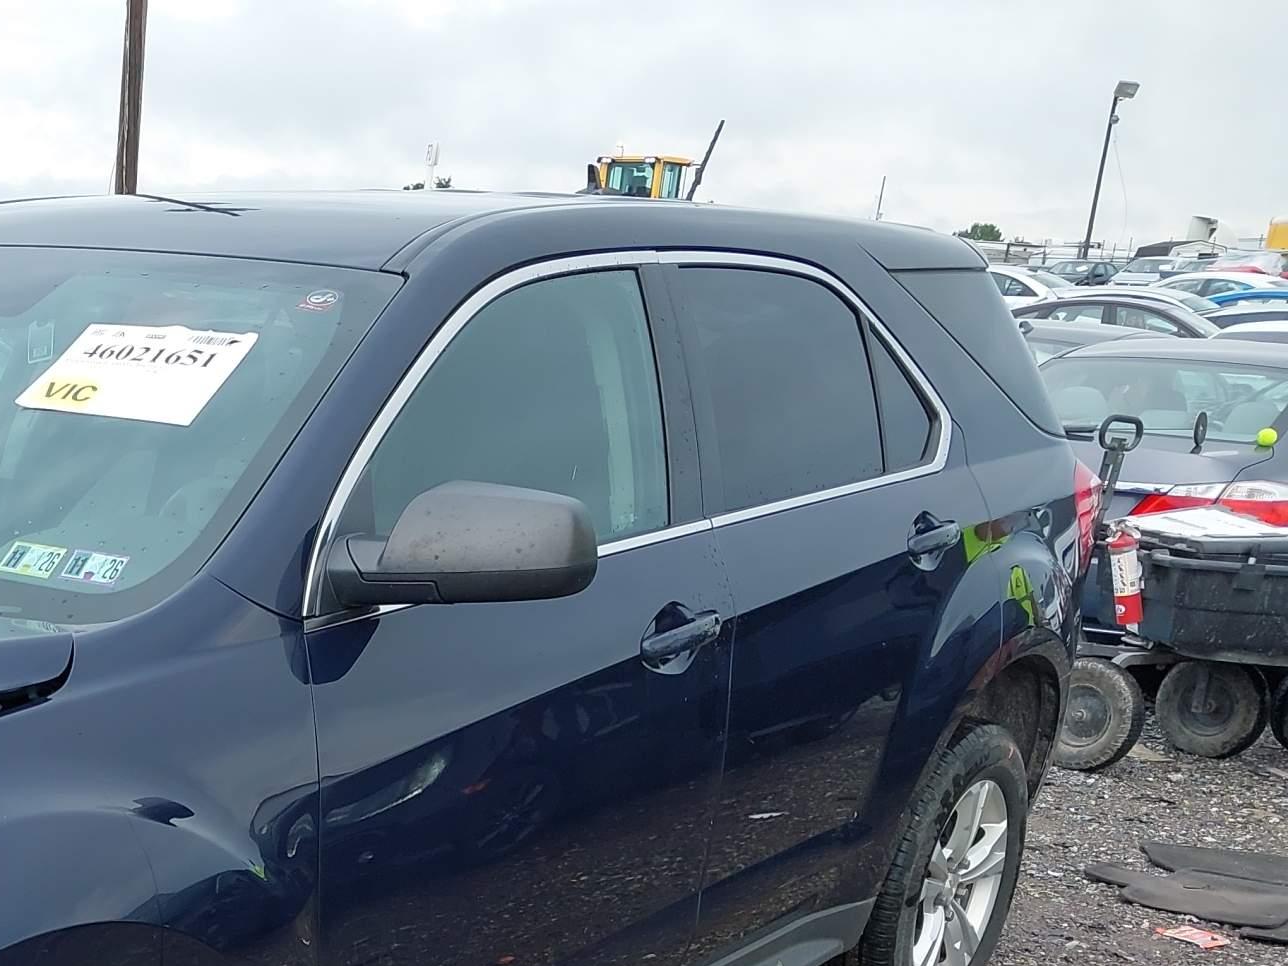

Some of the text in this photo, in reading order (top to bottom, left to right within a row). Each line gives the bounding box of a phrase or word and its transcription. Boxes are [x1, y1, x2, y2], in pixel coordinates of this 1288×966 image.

[83, 343, 218, 368] 46021651
[45, 382, 99, 402] VIC
[39, 551, 61, 573] 26
[101, 558, 124, 580] 26
